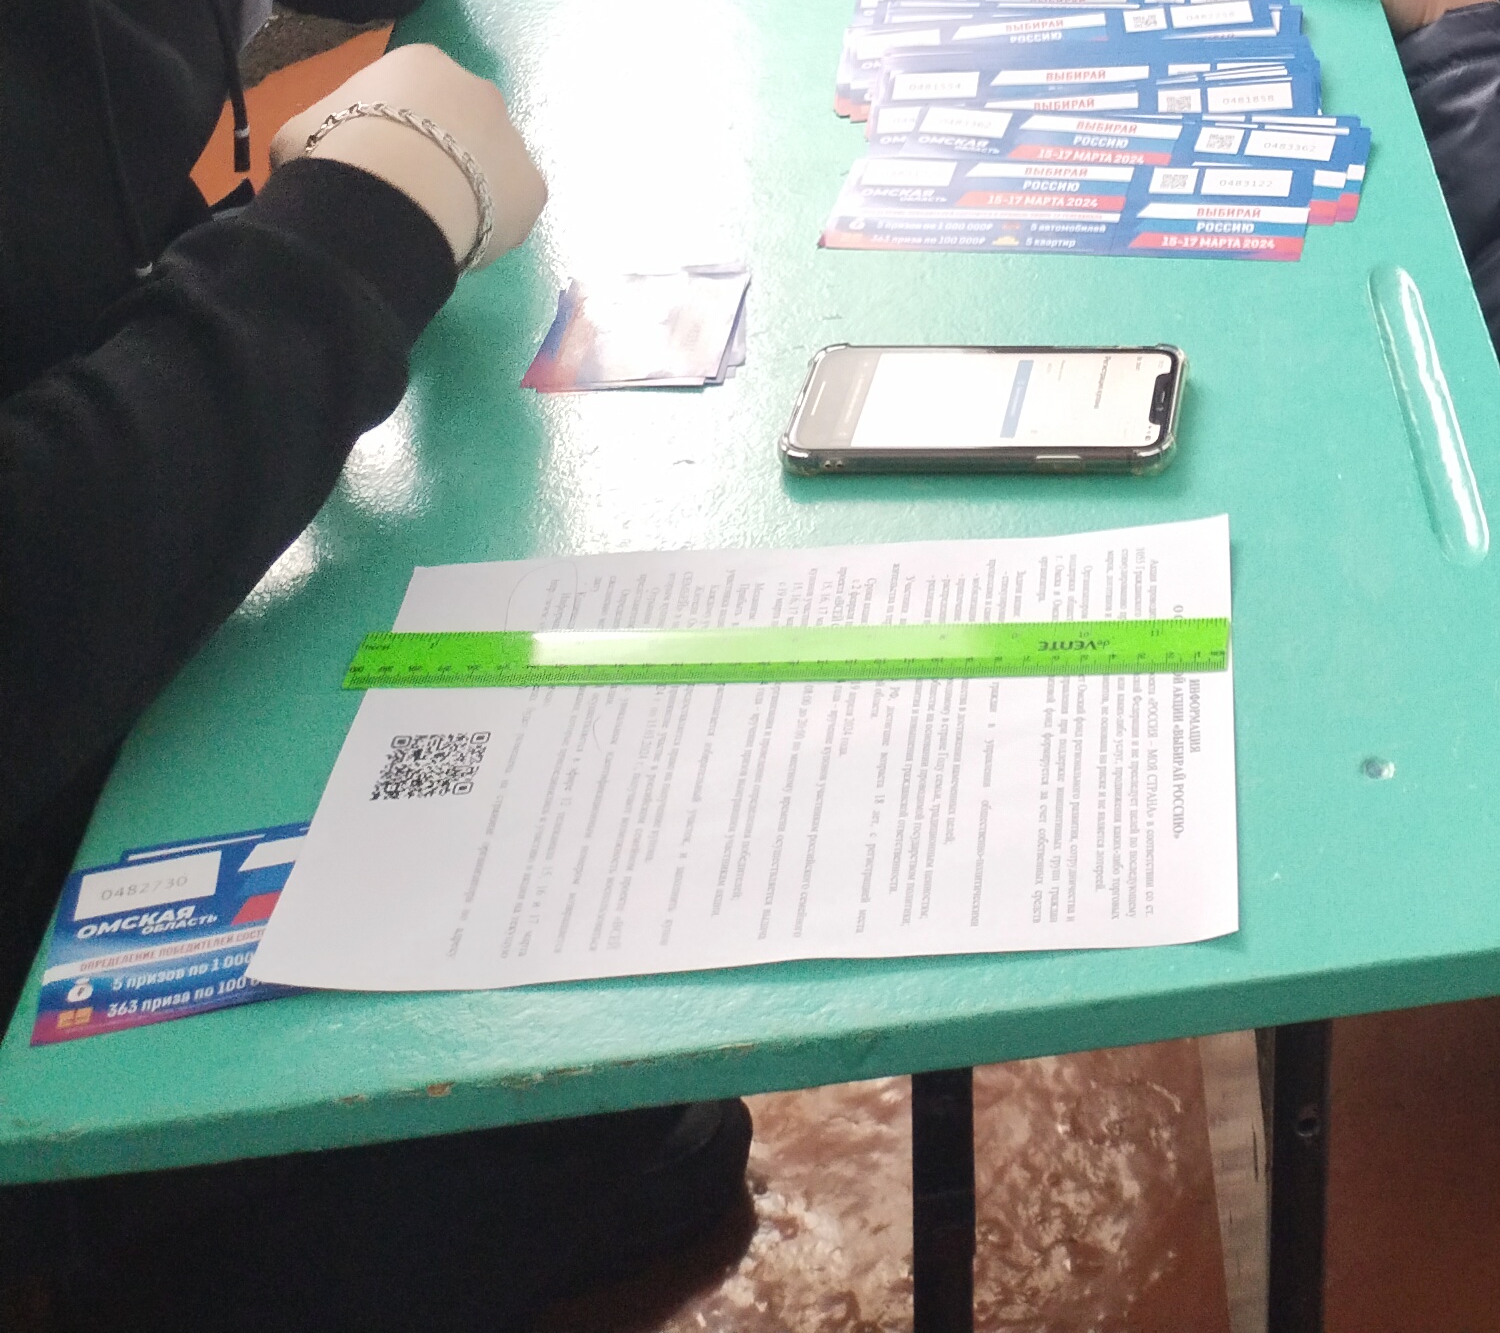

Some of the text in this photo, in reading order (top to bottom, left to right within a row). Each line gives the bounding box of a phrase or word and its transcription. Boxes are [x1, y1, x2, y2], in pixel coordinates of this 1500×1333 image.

[1005, 19, 1064, 32] ВЫБИРАЙ
[1046, 69, 1106, 82] ВЫБИРАЙ
[1033, 97, 1095, 111] ВЫБИРАЙ
[918, 135, 989, 148] ОМСКАЯ
[1073, 134, 1129, 149] РОССИЮ
[1076, 120, 1137, 134] ВЫБИРАЙ
[1037, 148, 1145, 165] 15-17 МАРТА 2024
[1263, 142, 1317, 153] 0483362
[1022, 180, 1080, 192] РОССИЮ
[1025, 167, 1088, 178] ВЫБИРАЙ
[1219, 179, 1273, 188] 0483122
[862, 188, 934, 198] ОМСКАЯ
[987, 194, 1098, 208] 15-17 МАРТА 2024
[1196, 207, 1261, 218] ВЫБИРАЙ
[1161, 236, 1276, 249] 15-17 МАРТА 2024
[1196, 222, 1254, 234] РОССИЮ
[1074, 684, 1086, 714] Омский
[1171, 686, 1184, 722] АКЦИИ
[1114, 693, 1125, 737] каких-либо
[1146, 697, 1157, 738] «РОССИЯ
[1189, 678, 1200, 753] ИНФОРМАЦИЯ
[1145, 749, 1156, 770] МОЯ
[1172, 724, 1185, 781] «ВЫБИРАЙ
[1070, 739, 1084, 798] регионального
[1128, 761, 1139, 806] преследует
[1145, 774, 1156, 817] СТРАНА»
[1172, 783, 1184, 838] РОССИЮ»
[1036, 804, 1049, 823] счет
[1032, 828, 1047, 884] собственных
[1110, 825, 1122, 875] каких-либо
[1144, 829, 1154, 887] соответствии
[101, 875, 188, 901] 0482730
[1064, 844, 1079, 913] сотрудничества
[1125, 850, 1137, 918] последующему
[1030, 890, 1044, 923] средств
[1109, 877, 1121, 919] торговых
[76, 905, 196, 939] ОМСКАЯ
[142, 915, 217, 935] ОБЛАСТЬ
[80, 951, 155, 972] ОПРЕДЕЛЕНИЕ
[158, 936, 233, 956] ПОБЕДИТЕЛЕЙ
[112, 977, 122, 991] 5
[126, 966, 185, 990] призов
[188, 964, 208, 979] по
[211, 958, 220, 972] 1
[107, 978, 246, 1018] 363 приза по 100
